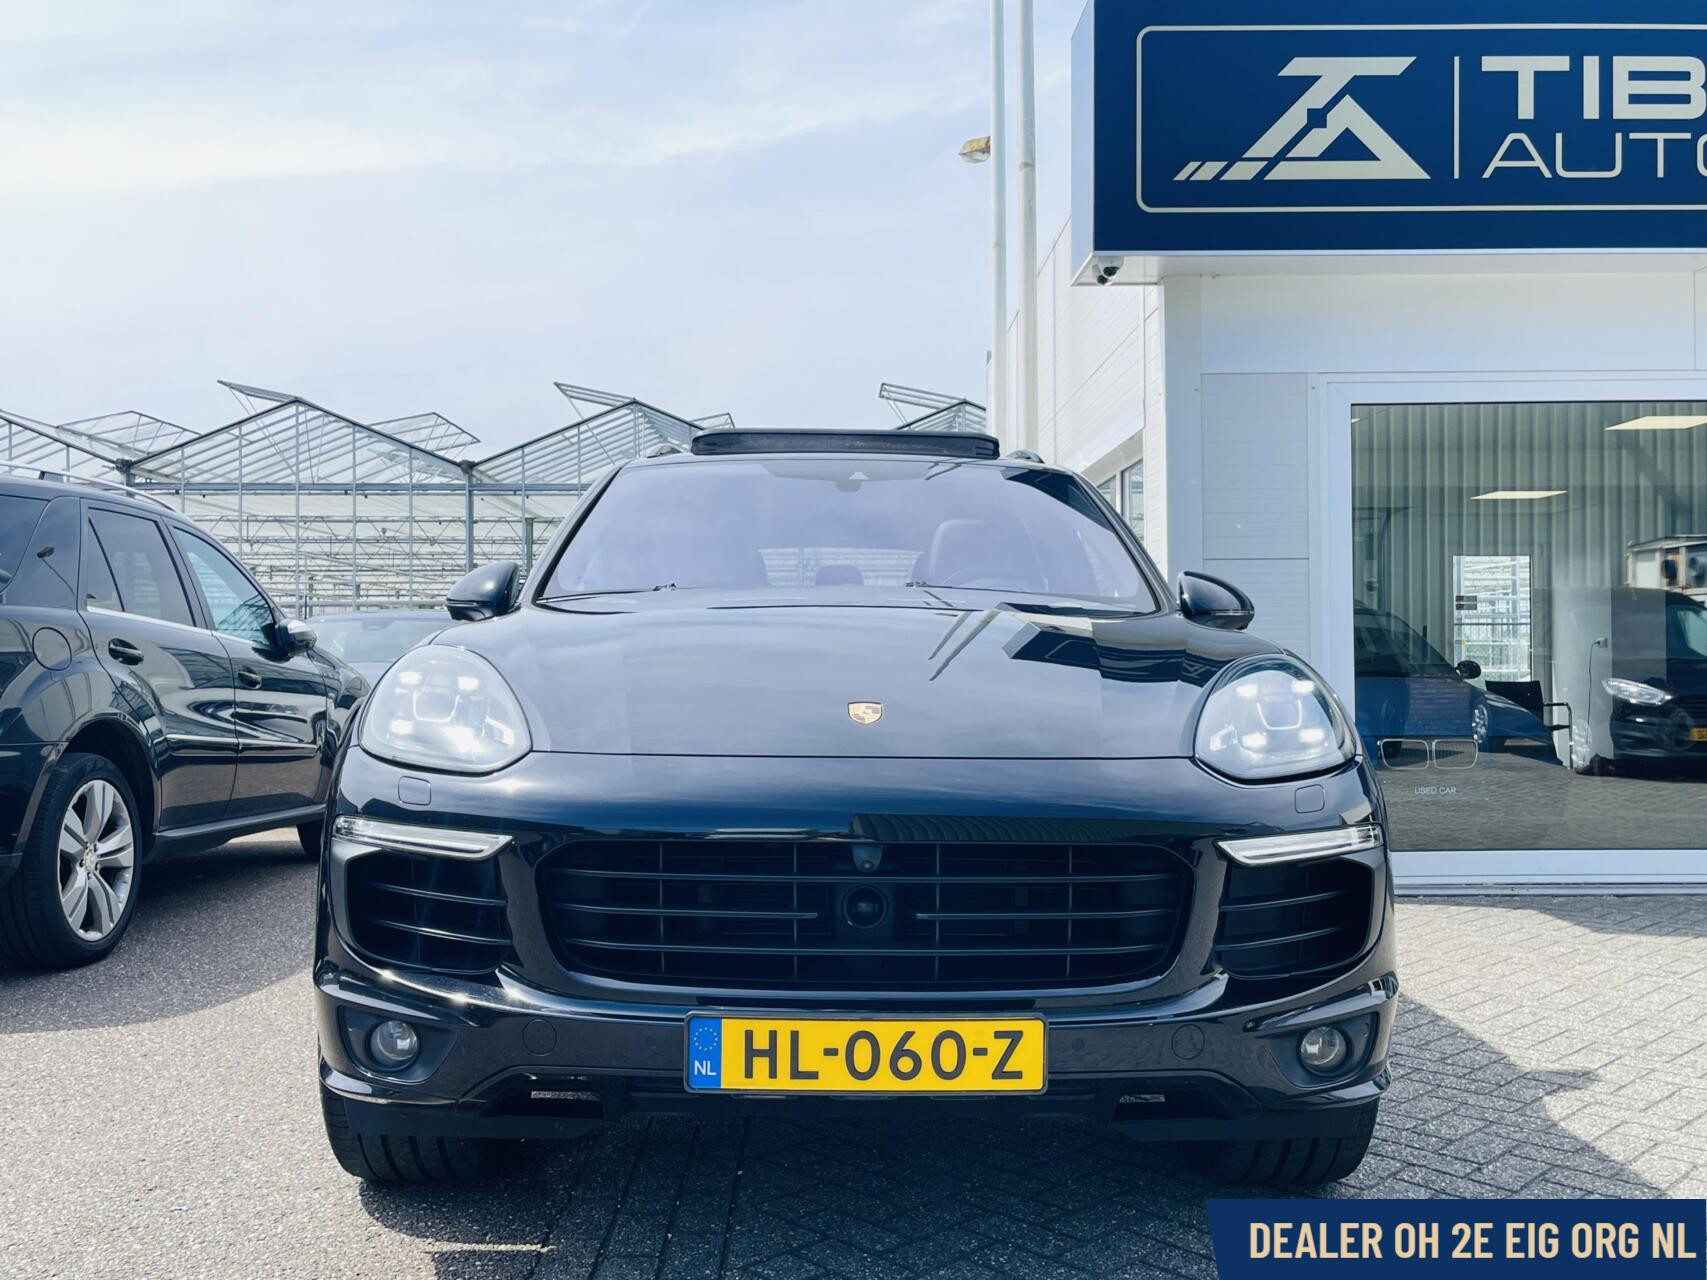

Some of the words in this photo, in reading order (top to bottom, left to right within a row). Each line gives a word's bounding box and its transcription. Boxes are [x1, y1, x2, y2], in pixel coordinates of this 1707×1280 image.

[1481, 55, 1707, 120] TIB
[1481, 132, 1707, 179] AUT
[1414, 786, 1437, 795] USED
[1438, 786, 1457, 795] CAR
[694, 1060, 717, 1076] NL
[744, 1029, 1024, 1081] HL-060-Z
